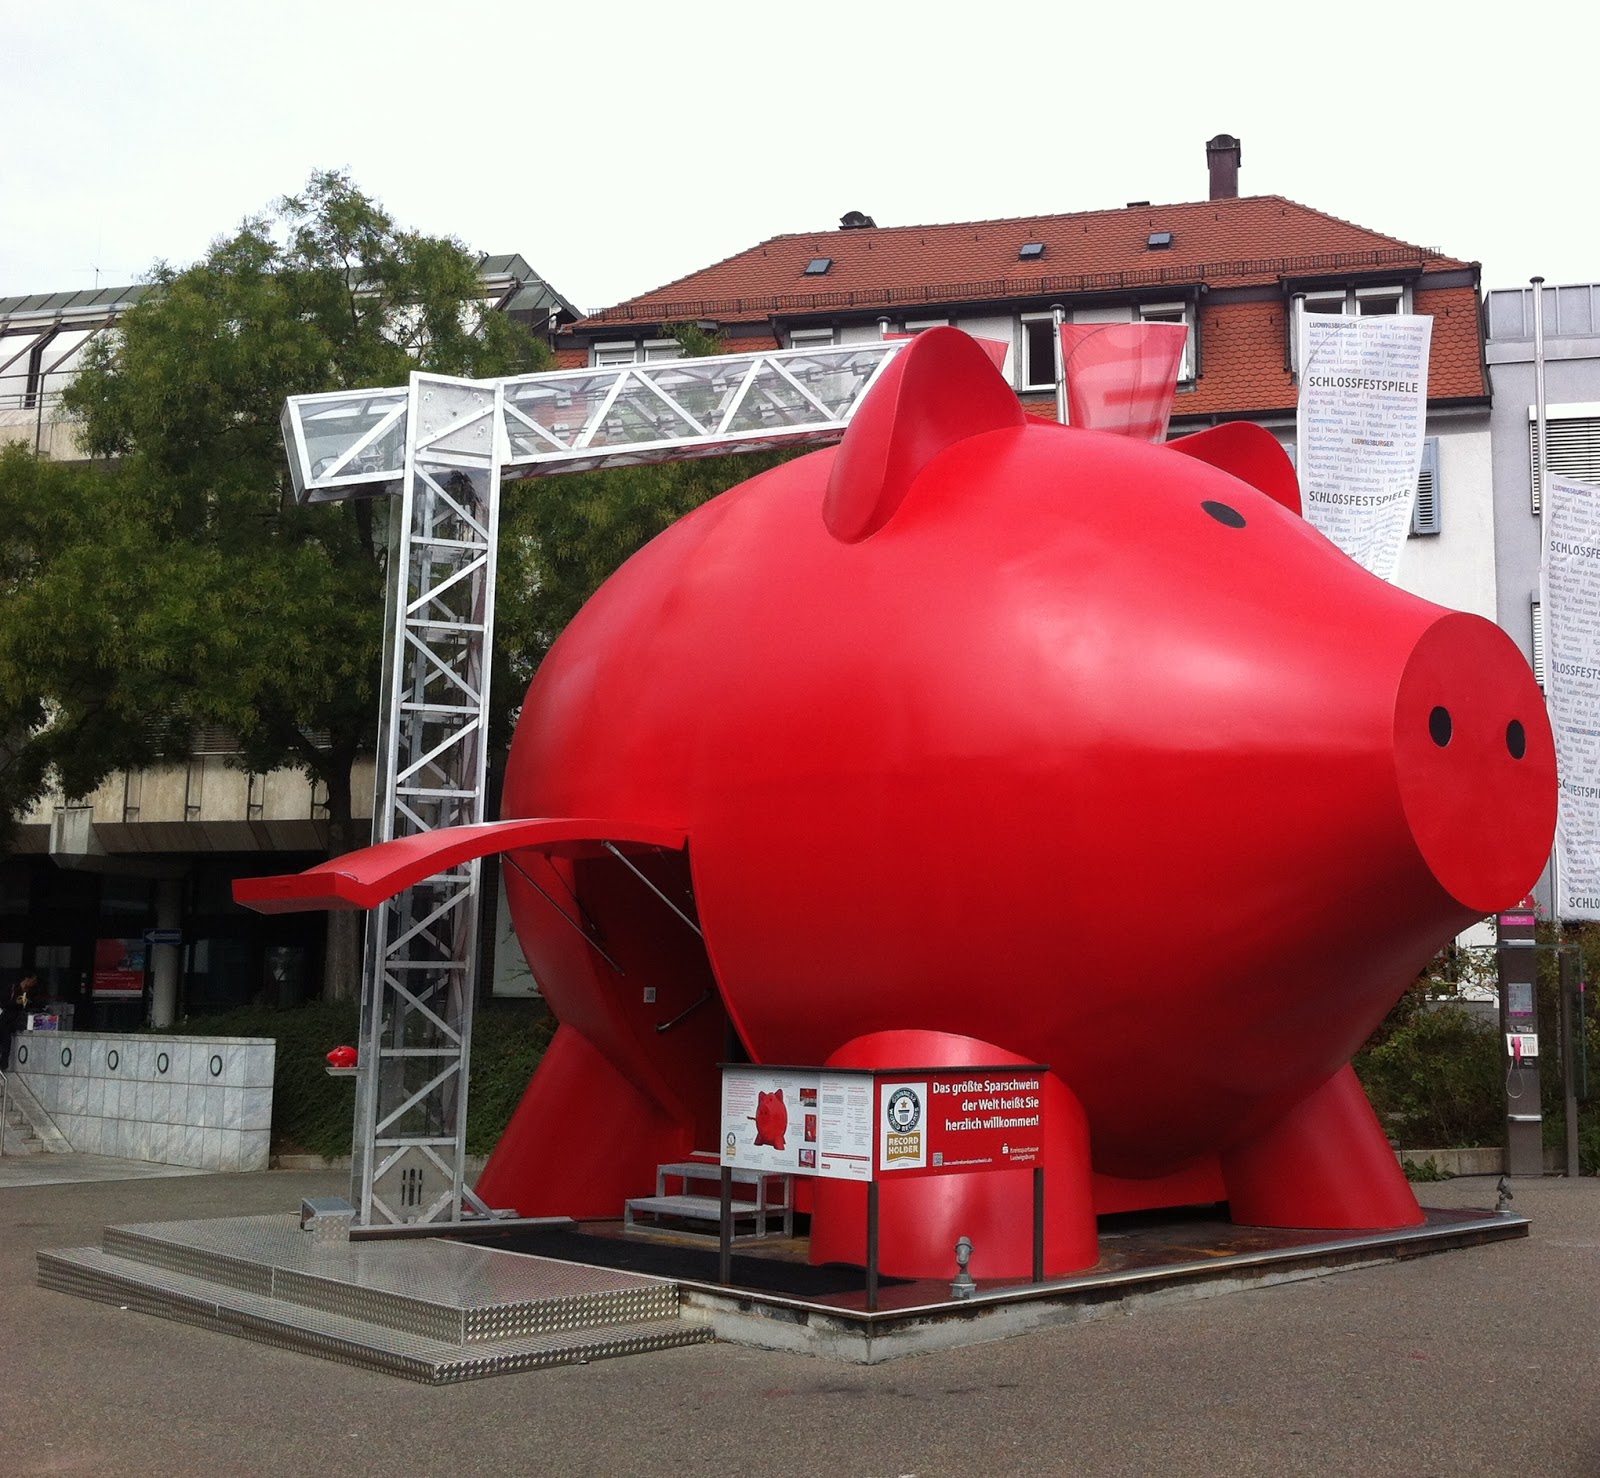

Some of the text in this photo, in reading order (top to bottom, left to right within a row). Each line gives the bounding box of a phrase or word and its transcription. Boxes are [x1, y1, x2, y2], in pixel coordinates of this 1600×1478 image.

[1309, 376, 1418, 393] SCHLOSSFESTSPIELE
[1309, 489, 1411, 506] SCHLOSSFESTSPIELE
[1550, 541, 1600, 560] SCHLOSSFE
[932, 1078, 1039, 1096] Das größte Sparschwein
[962, 1096, 1039, 1111] der Welt heißt Sie
[945, 1114, 1039, 1132] herzlich willkommen!
[888, 1136, 919, 1146] RECORD
[888, 1145, 919, 1155] HOLDER
